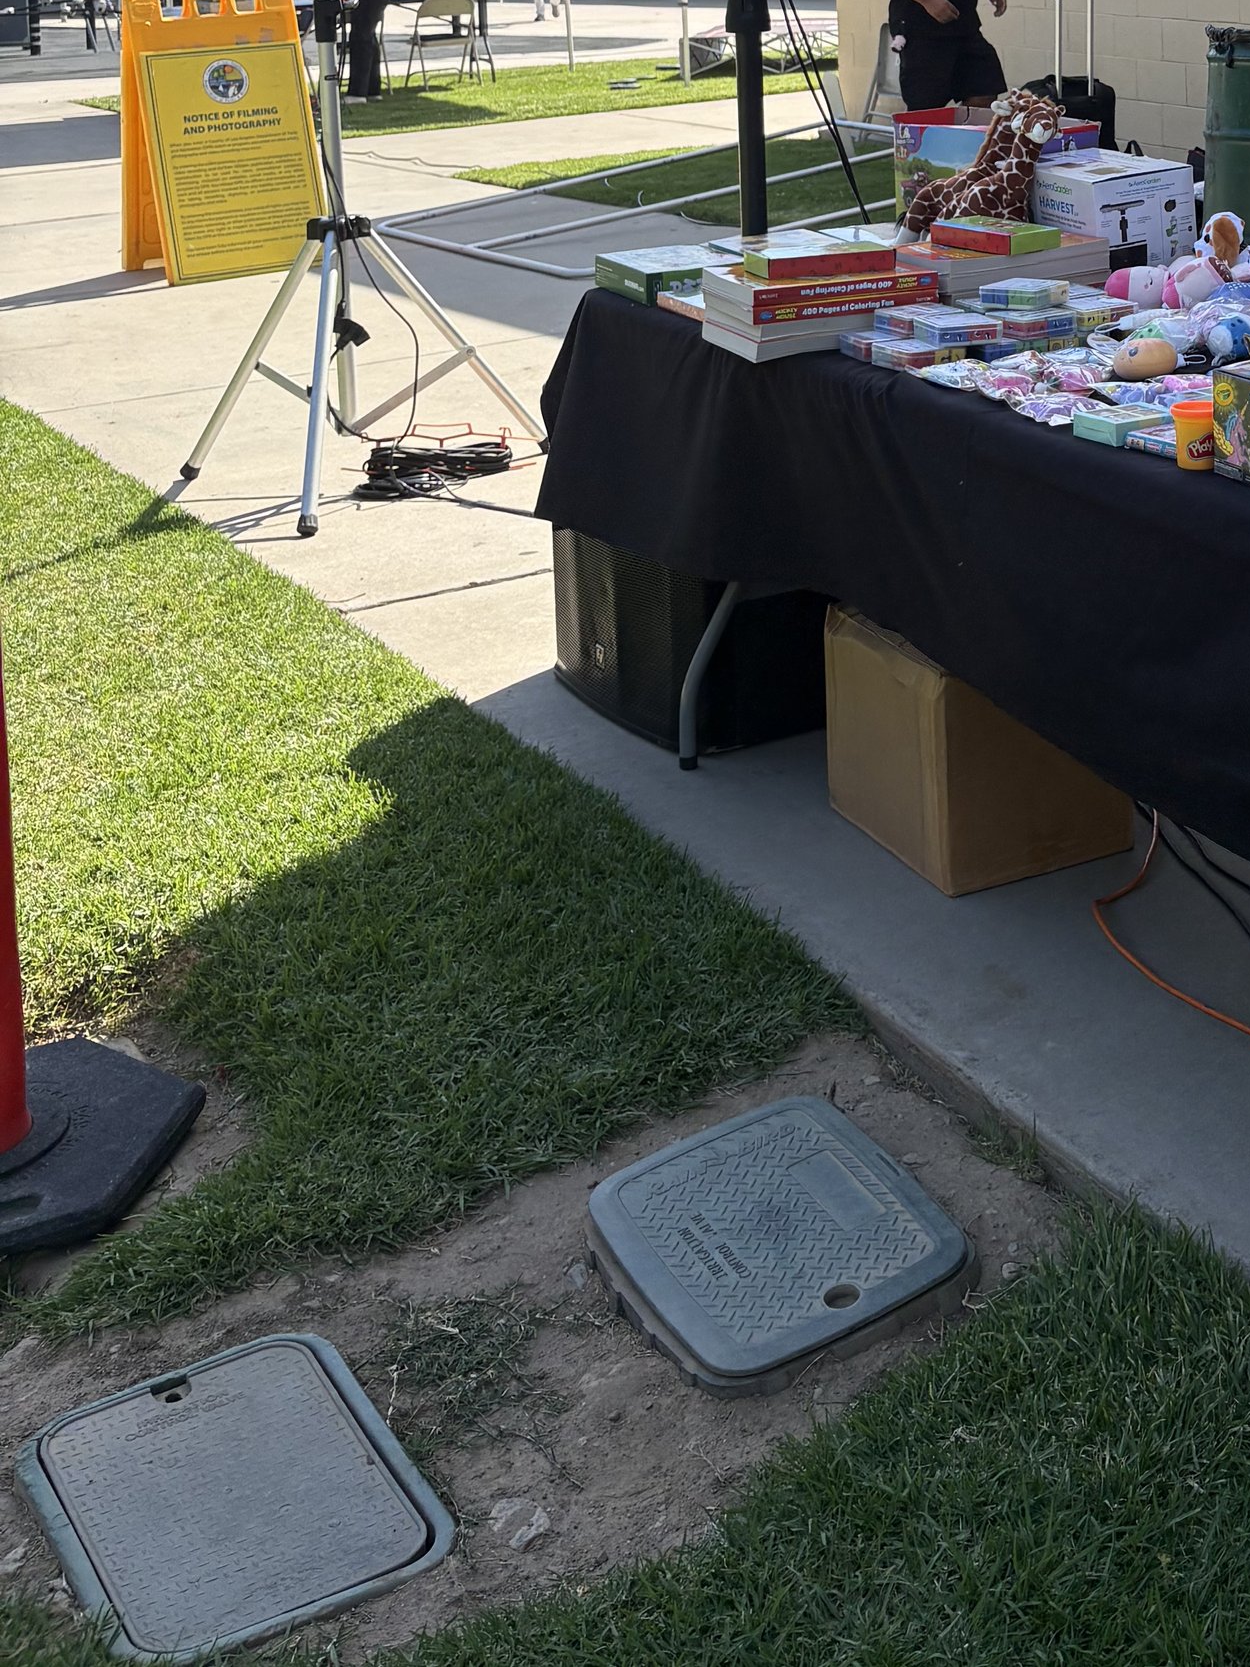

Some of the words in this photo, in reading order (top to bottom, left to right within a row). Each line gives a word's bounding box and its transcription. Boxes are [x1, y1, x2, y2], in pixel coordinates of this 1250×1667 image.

[183, 112, 219, 124] NOTICE
[221, 110, 235, 119] OF
[236, 106, 278, 118] FILMING
[183, 125, 205, 135] AND
[207, 118, 281, 132] PHOTOGRAPHY
[1039, 196, 1074, 215] HARVEST
[815, 286, 846, 295] Coloring
[855, 282, 877, 291] Pages
[877, 281, 893, 289] 400
[802, 307, 817, 316] 400
[818, 305, 840, 315] Pages
[841, 303, 849, 311] of
[849, 300, 880, 311] Coloring
[881, 299, 894, 307] Fun
[1189, 437, 1213, 457] Play
[677, 1227, 728, 1281] IRRIGATION
[715, 1242, 752, 1279] CONTROL
